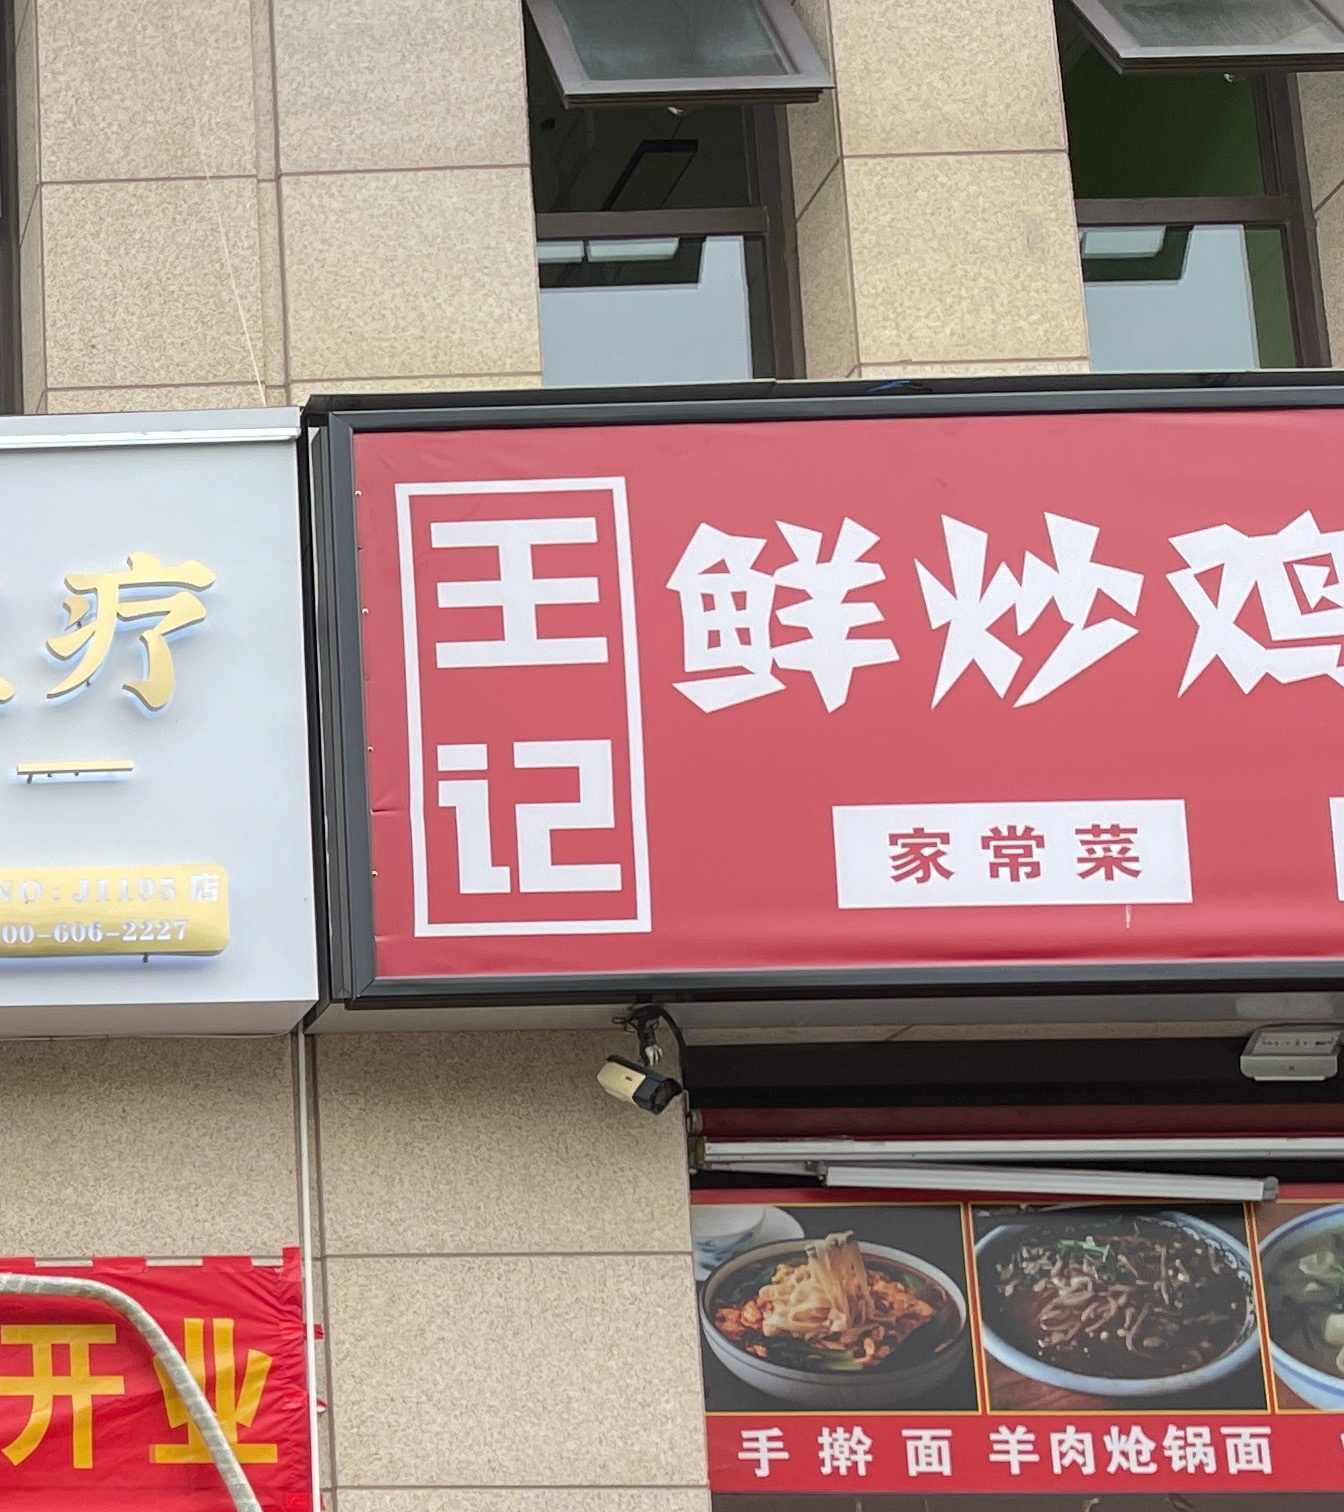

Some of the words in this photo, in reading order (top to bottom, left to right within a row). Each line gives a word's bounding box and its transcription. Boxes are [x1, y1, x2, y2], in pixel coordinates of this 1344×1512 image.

[666, 508, 1344, 713] 鲜炒鸡
[430, 516, 623, 894] 王记
[887, 823, 1143, 886] 家常菜
[737, 1426, 954, 1478] 手擀面
[988, 1424, 1272, 1475] 羊肉炝锅面
